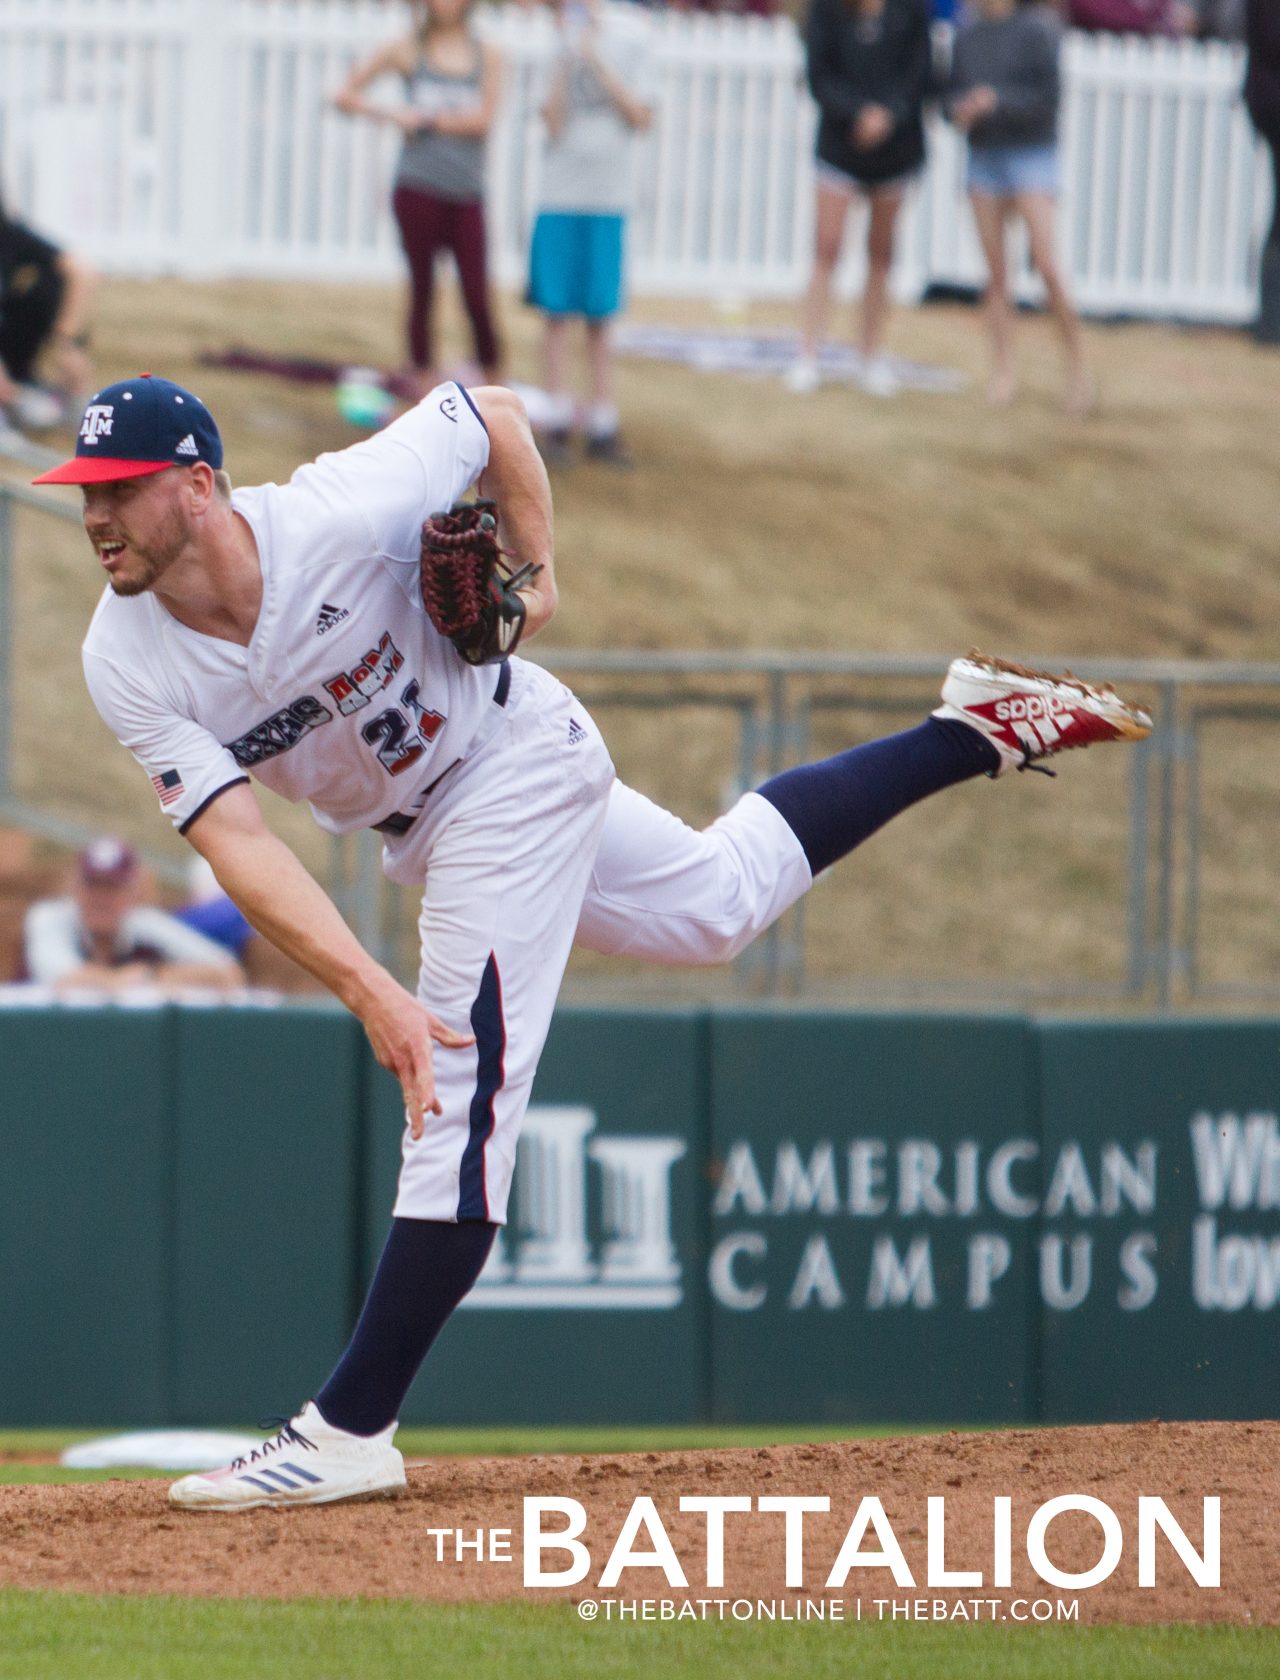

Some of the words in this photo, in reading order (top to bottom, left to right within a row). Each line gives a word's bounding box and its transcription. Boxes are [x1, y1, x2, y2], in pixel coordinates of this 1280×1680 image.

[222, 695, 334, 768] EXAS
[322, 630, 405, 717] A&M
[361, 668, 448, 777] 21
[714, 1138, 1158, 1218] AMERICAN
[708, 1231, 1158, 1310] CAMPUS
